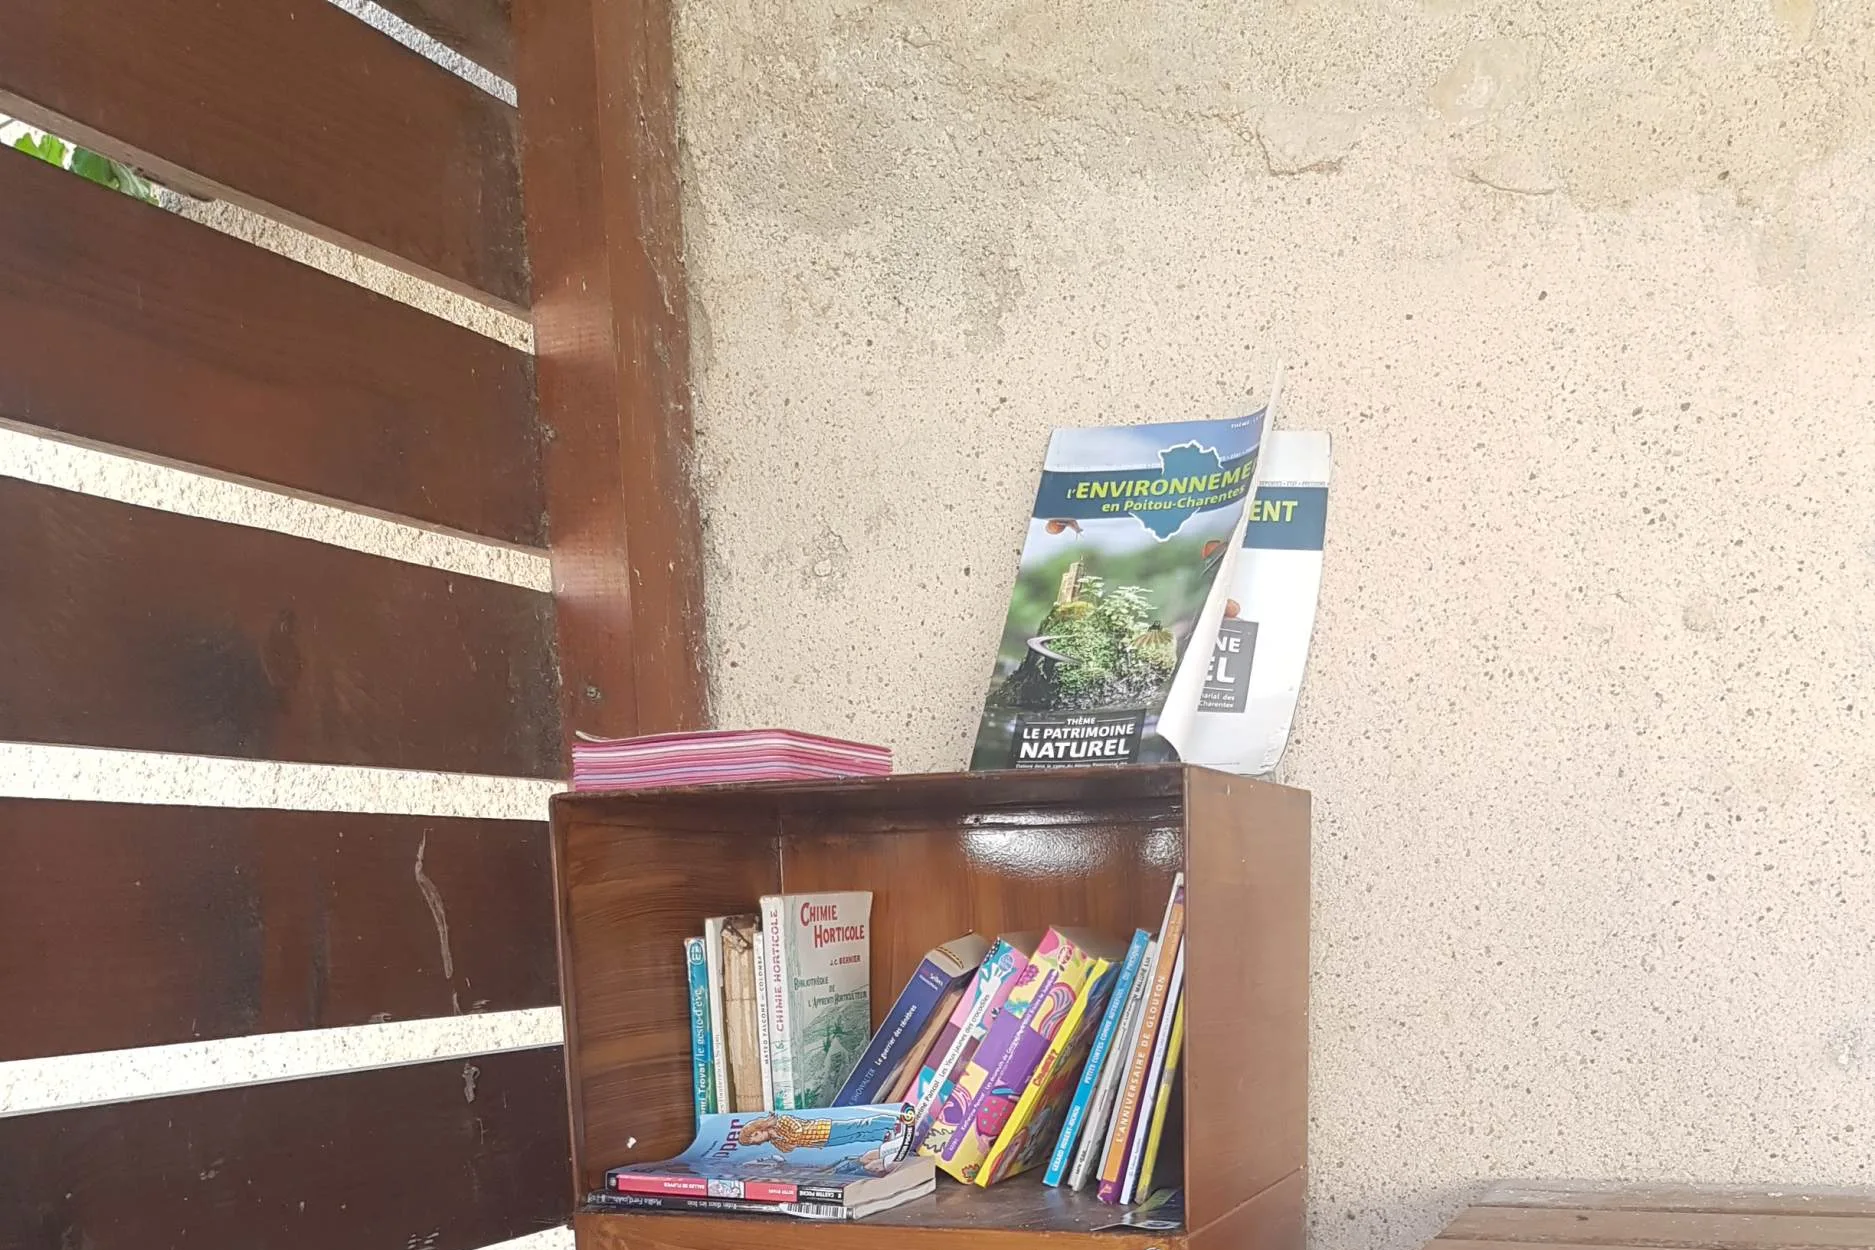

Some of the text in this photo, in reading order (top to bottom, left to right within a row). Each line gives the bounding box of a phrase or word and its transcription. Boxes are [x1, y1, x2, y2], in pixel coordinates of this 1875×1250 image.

[1066, 459, 1257, 500] l'ENVIRONNEME
[1102, 485, 1245, 512] en Poitou-Charentes
[1023, 723, 1134, 739] LE PATRIMOINE
[1067, 717, 1095, 725] THÈME
[1020, 738, 1130, 758] NATUREL
[801, 902, 838, 926] CHIMIE
[815, 925, 865, 948] HORTICOLE
[756, 955, 764, 991] COLOMBA
[769, 910, 784, 1031] CHIMIE HORTICOLE
[1144, 974, 1166, 1028] GLOUTON
[874, 1057, 882, 1065] Le
[879, 1036, 897, 1060] guerrier
[892, 1026, 902, 1037] des
[898, 1002, 917, 1028] ténèbres
[923, 1079, 940, 1102] Pancol
[938, 1066, 948, 1078] Les
[944, 1051, 957, 1067] Yeux
[952, 1031, 970, 1054] jaunes
[963, 1021, 974, 1033] des
[969, 992, 991, 1023] crocodiles
[1140, 1031, 1150, 1047] DE
[1083, 1063, 1096, 1084] PETITS
[1090, 1040, 1104, 1064] CONTES
[1098, 1019, 1112, 1041] COMME
[1114, 1051, 1146, 1143] L'ANNIVERSAIRE
[816, 1190, 834, 1198] CASTOR
